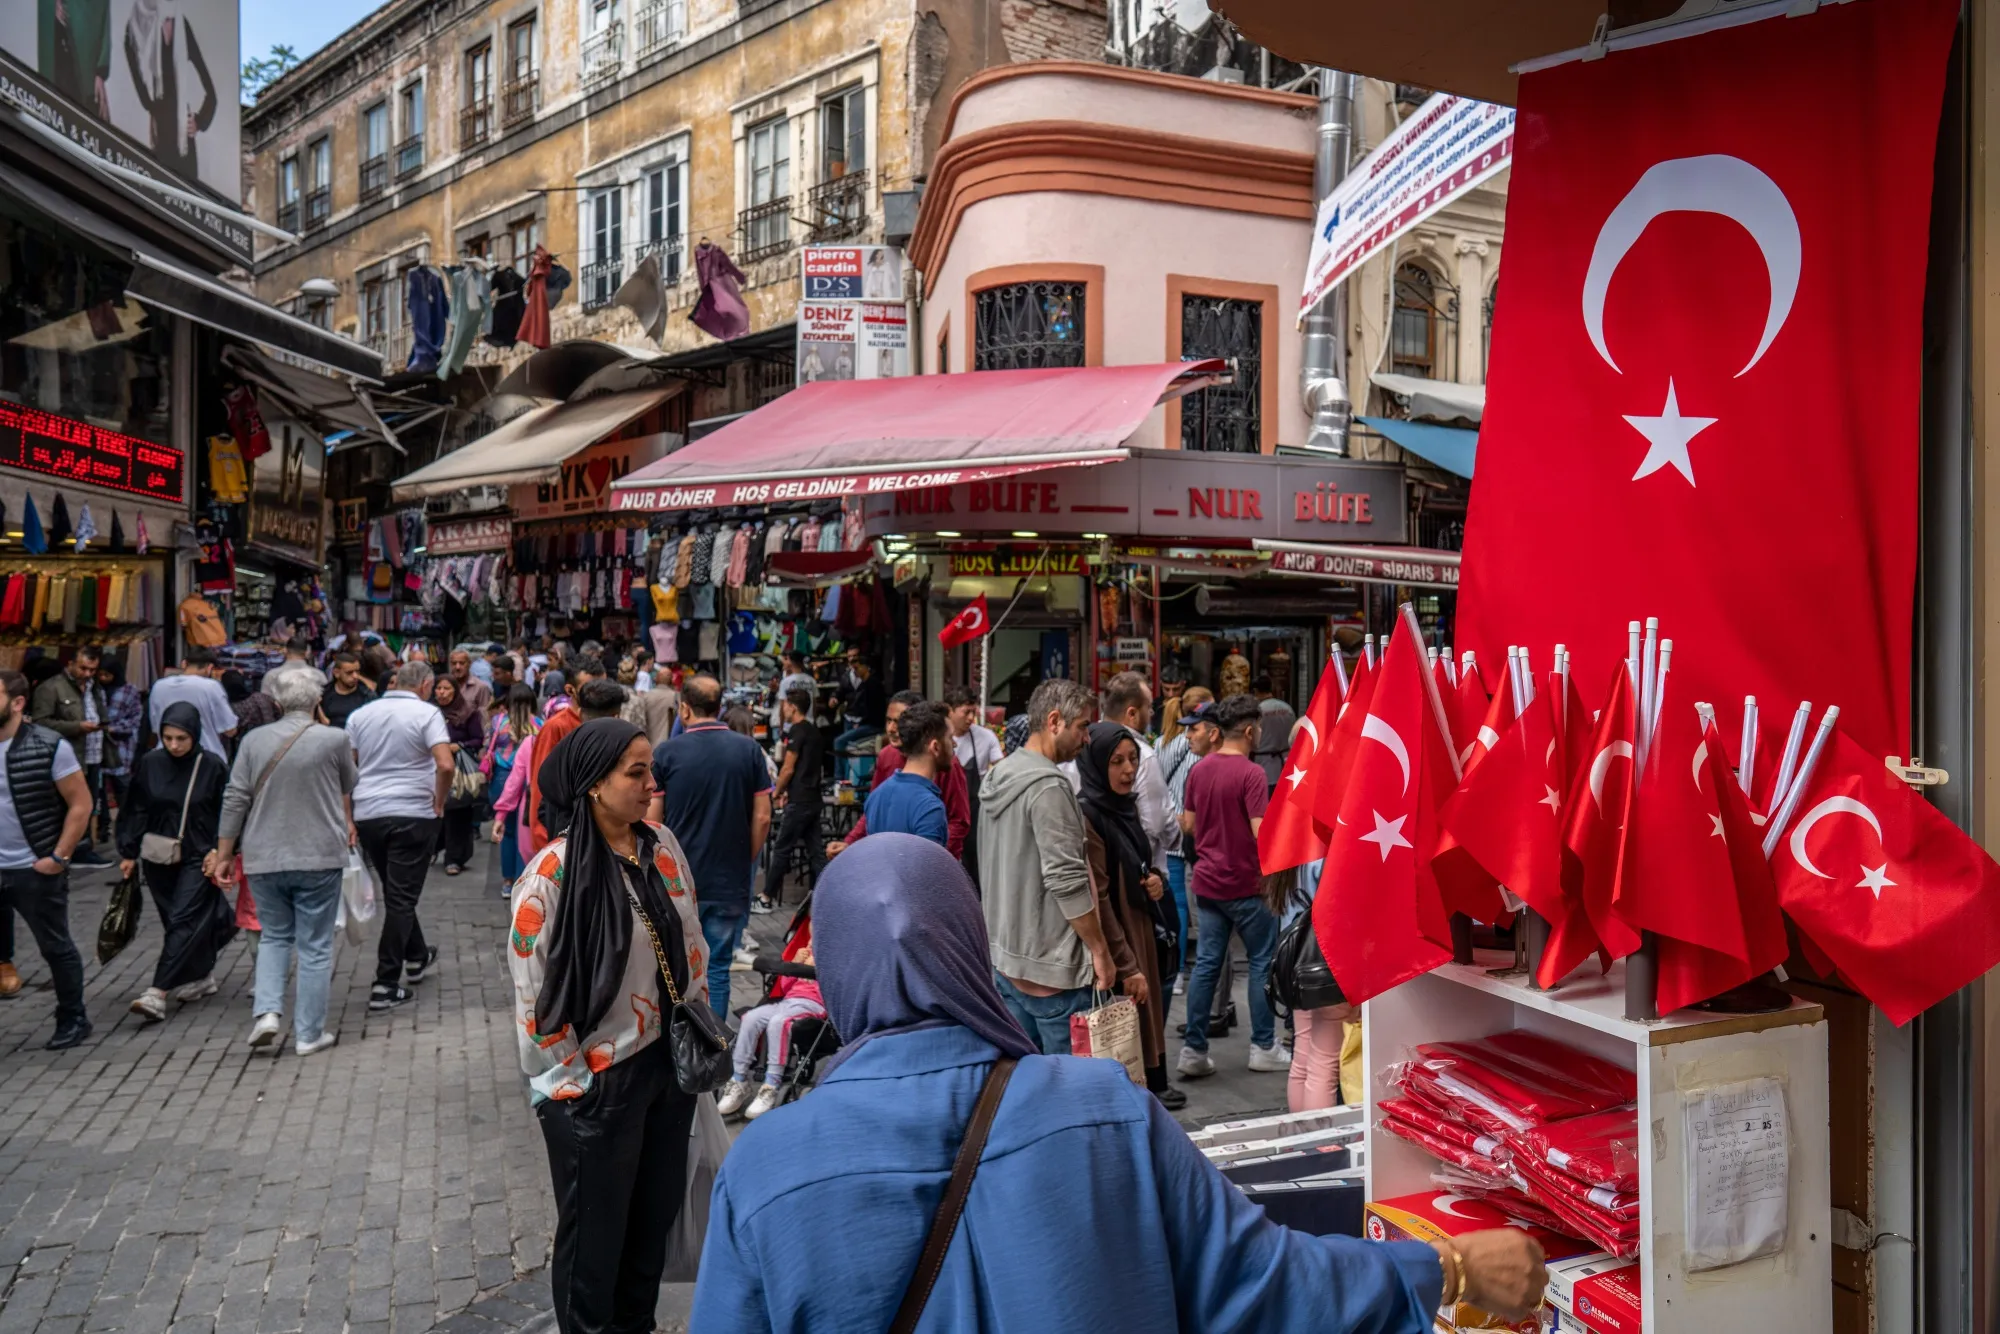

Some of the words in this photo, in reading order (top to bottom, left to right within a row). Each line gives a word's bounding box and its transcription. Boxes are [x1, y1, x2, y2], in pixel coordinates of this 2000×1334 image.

[807, 250, 856, 262] pierre
[806, 262, 857, 273] cardin
[812, 276, 850, 291] D'S
[804, 303, 854, 322] DENİZ
[620, 492, 656, 509] NUR
[658, 488, 716, 508] DÖNER
[733, 485, 770, 502] HOŞ
[774, 477, 857, 498] GELDİNİZ
[867, 471, 961, 491] WELCOME
[1189, 487, 1263, 520] NUR
[1295, 481, 1373, 523] BÜFE
[1590, 1305, 1621, 1330] ALSANCAK
